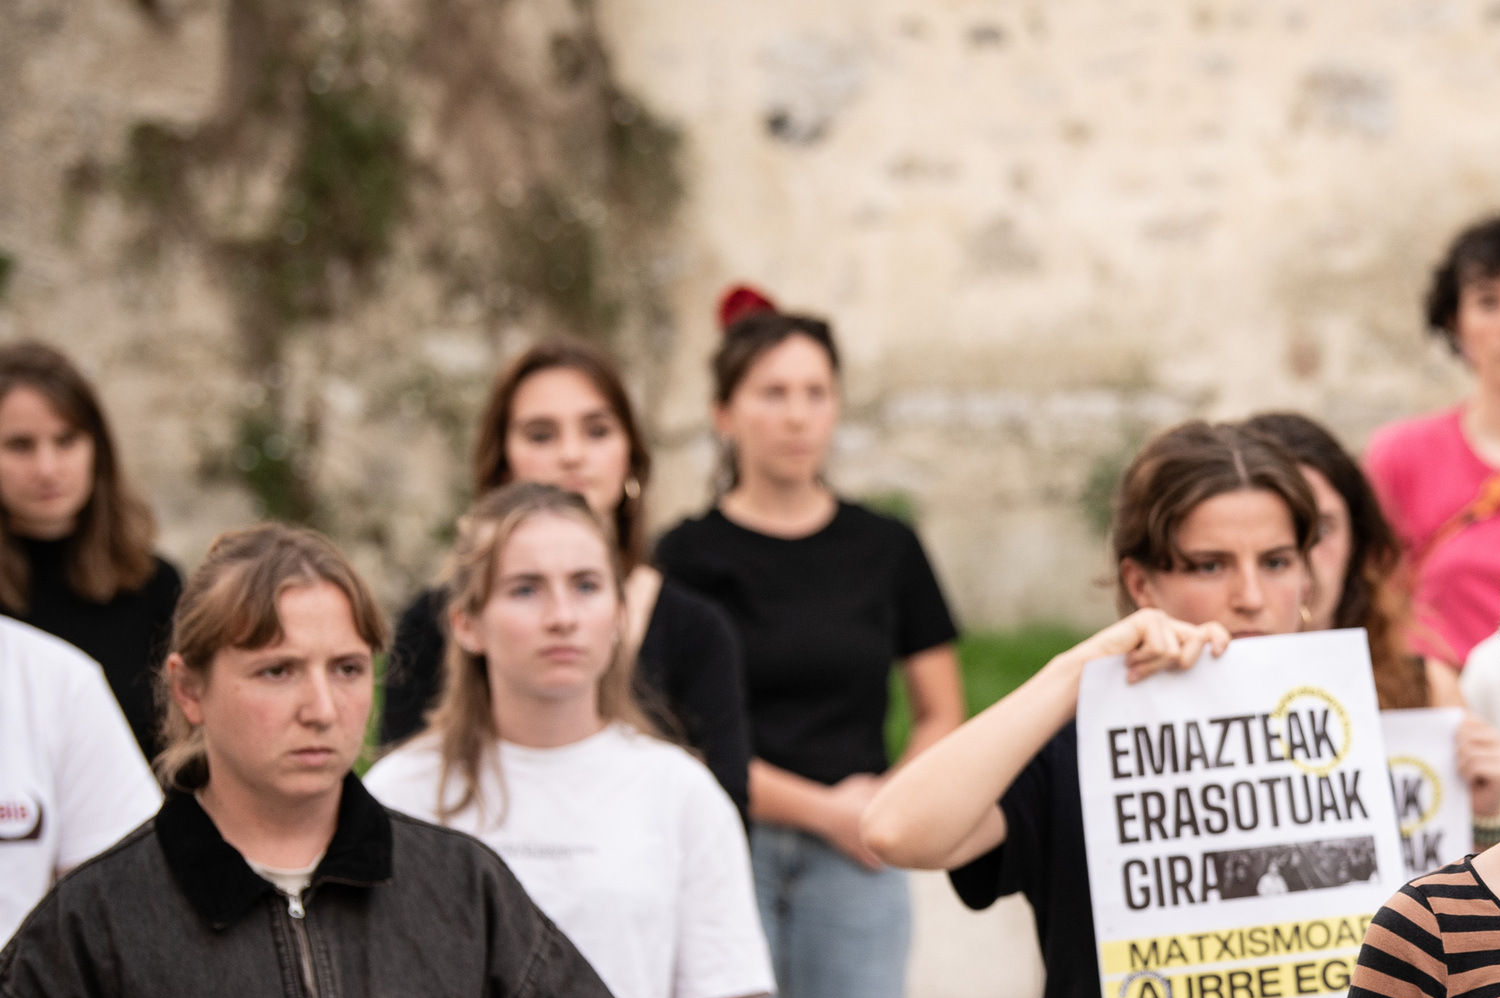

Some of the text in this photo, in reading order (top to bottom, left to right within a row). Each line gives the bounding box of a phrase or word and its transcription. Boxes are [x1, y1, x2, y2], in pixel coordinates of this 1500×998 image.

[1107, 709, 1338, 779] EMAZTEAK
[1115, 770, 1368, 844] ERASOTUAK
[1122, 853, 1221, 911] GIRA
[1294, 957, 1357, 994] EG
